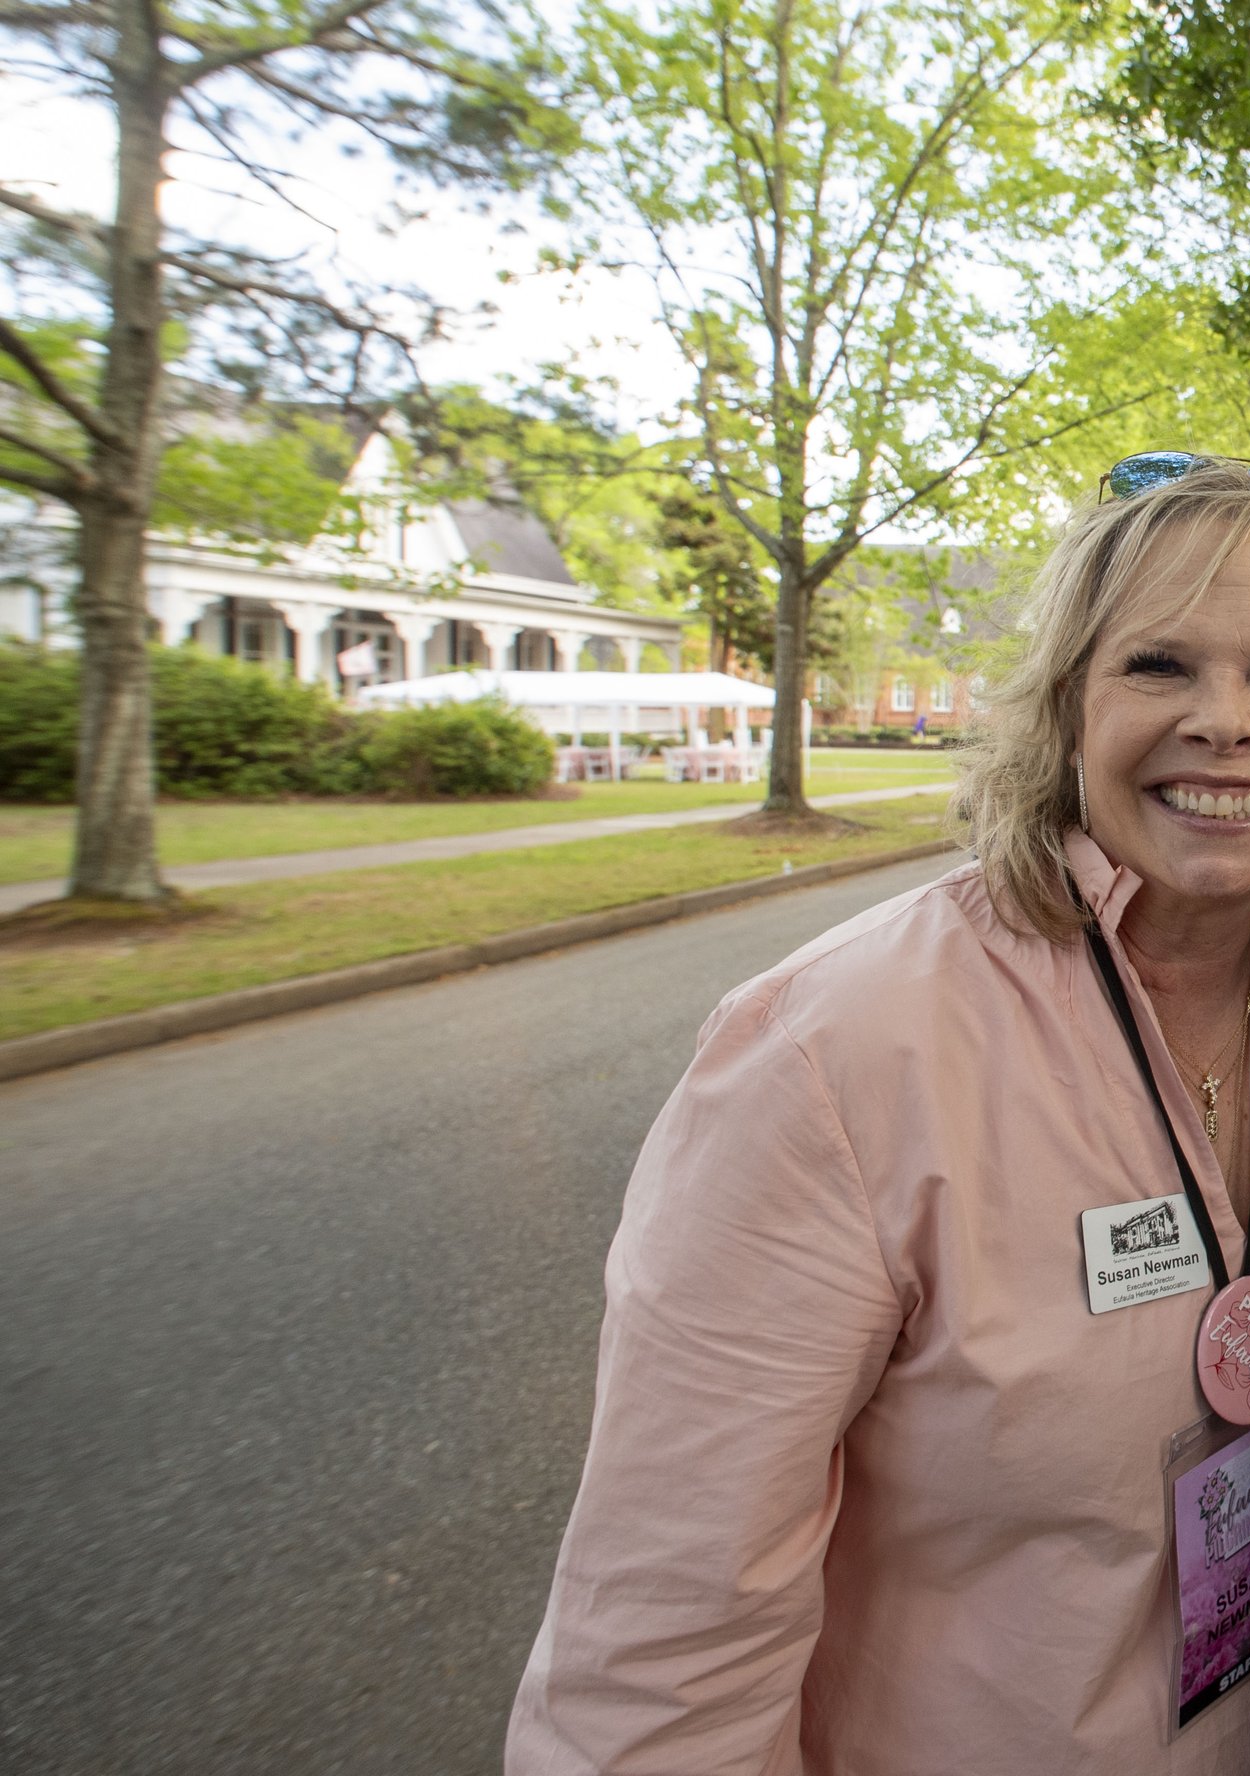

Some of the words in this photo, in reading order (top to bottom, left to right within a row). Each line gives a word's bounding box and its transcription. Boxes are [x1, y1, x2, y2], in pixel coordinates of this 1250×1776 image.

[1097, 1266, 1140, 1285] Susan
[1143, 1252, 1200, 1275] Newman
[1113, 1292, 1135, 1304] Eufaula
[1135, 1286, 1159, 1300] Heritage
[1159, 1279, 1190, 1293] Association
[1126, 1280, 1153, 1292] Executive
[1154, 1274, 1176, 1285] Director
